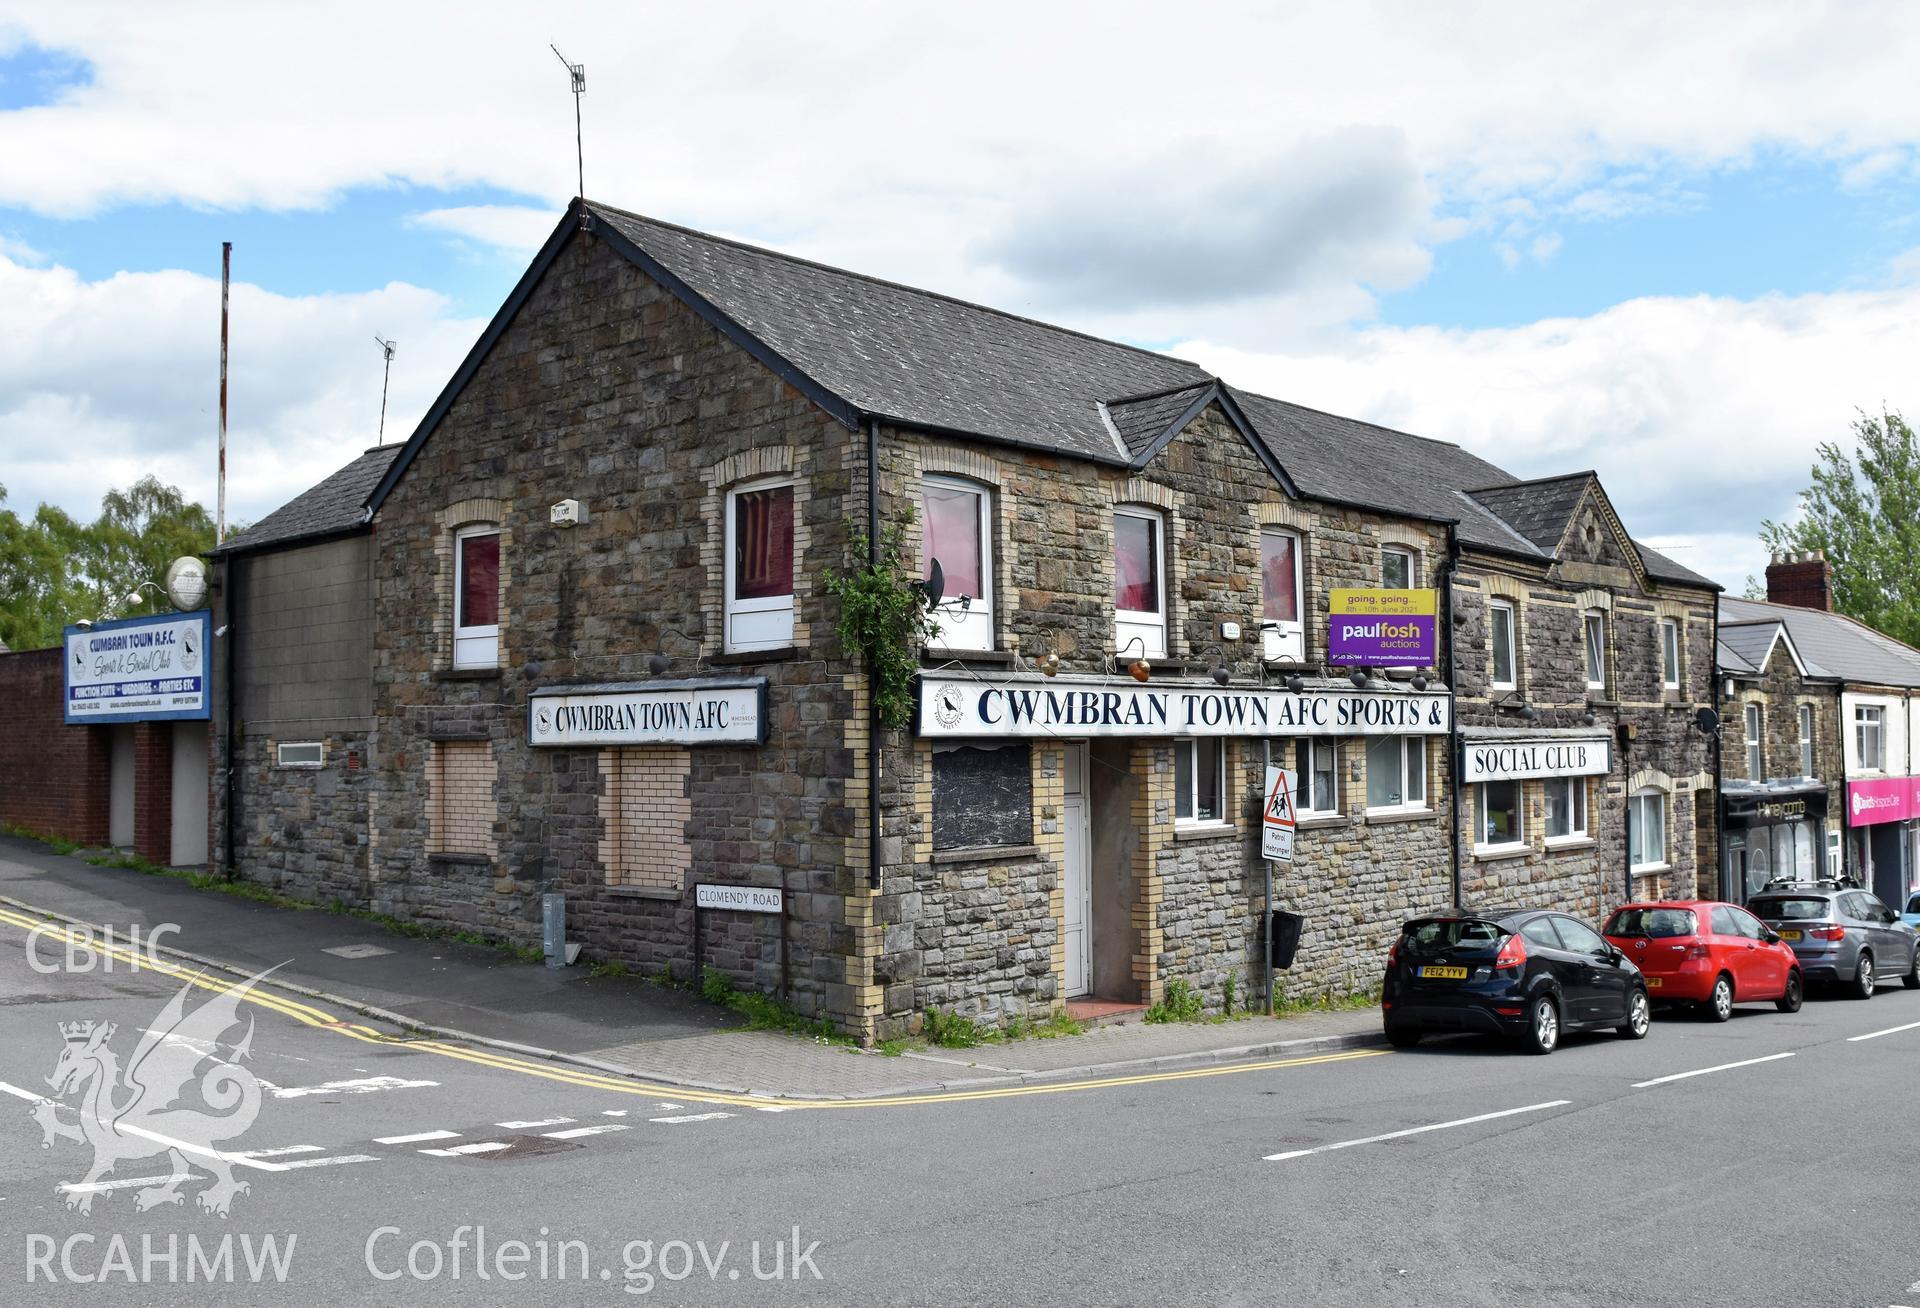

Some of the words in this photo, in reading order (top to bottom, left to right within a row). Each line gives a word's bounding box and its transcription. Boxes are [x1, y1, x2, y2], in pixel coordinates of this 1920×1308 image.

[1345, 605, 1357, 613] 8th
[1364, 605, 1379, 613] 10th
[1381, 605, 1399, 613] June
[1400, 605, 1418, 613] 2021
[1347, 595, 1377, 604] going,
[90, 635, 128, 653] CWMBRAN
[129, 631, 153, 649] TOWN
[154, 629, 176, 646] A.F.C.
[1343, 622, 1420, 641] paulfosh
[1380, 639, 1421, 649] auctions
[94, 655, 117, 681] Sports
[126, 652, 153, 674] Social
[152, 650, 171, 672] Club
[75, 687, 100, 698] FUNCTION
[100, 684, 116, 697] SUITE
[122, 682, 152, 695] WEDDINGS
[158, 679, 183, 693] PARTIES
[183, 678, 194, 691] ETC
[555, 703, 636, 732] CWMBRAN
[640, 702, 691, 730] TOWN
[694, 700, 729, 729] AFC
[978, 689, 1168, 725] CWMBRAN
[1182, 695, 1269, 726] TOWN
[1279, 697, 1328, 726] AFC
[1337, 698, 1420, 726] SPORTS
[1428, 700, 1442, 726] &
[1475, 747, 1541, 773] SOCIAL
[1545, 746, 1587, 769] CLUB
[1272, 832, 1285, 841] Patrol
[699, 891, 749, 903] CLOMENDY
[753, 894, 779, 905] ROAD
[1424, 967, 1444, 977] FE12
[1445, 967, 1464, 977] YYV
